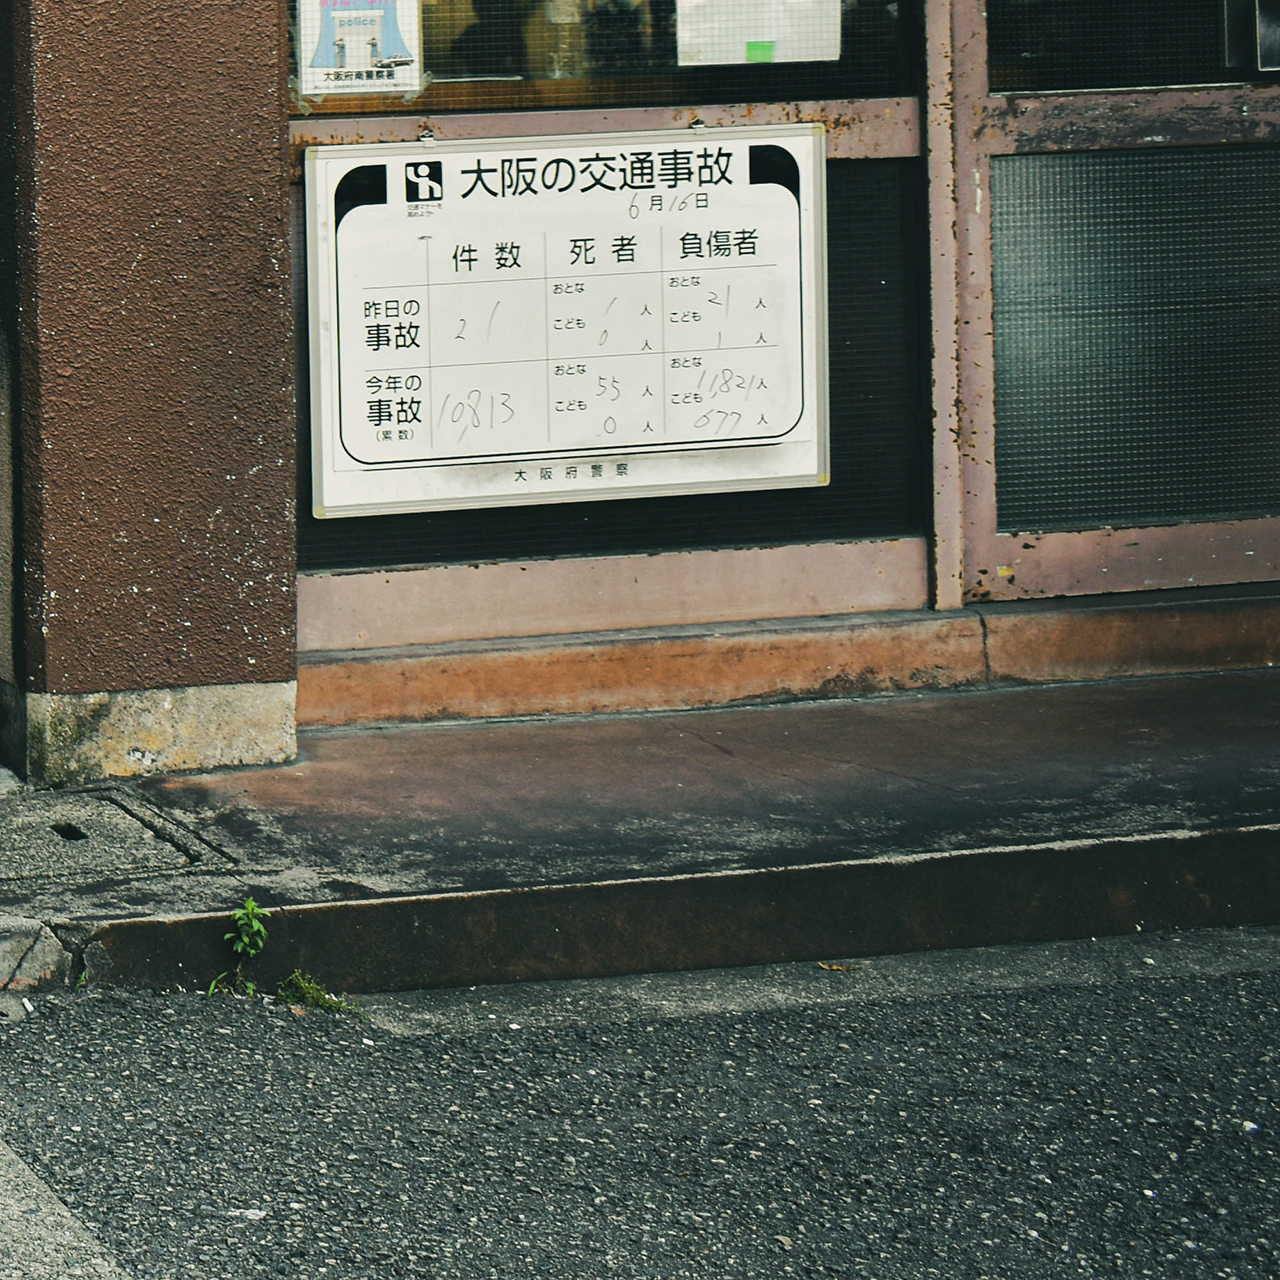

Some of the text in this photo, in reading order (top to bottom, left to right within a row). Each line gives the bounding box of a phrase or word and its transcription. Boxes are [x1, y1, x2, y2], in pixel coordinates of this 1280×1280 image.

[338, 16, 377, 29] police
[460, 146, 734, 200] 大阪の交通事故
[569, 235, 638, 265] 死者
[679, 228, 759, 260] 負傷者
[452, 241, 522, 272] 件数
[552, 282, 586, 295] おとな
[669, 276, 701, 288] おとな
[363, 299, 421, 319] 昨日の
[640, 303, 652, 316] 人
[755, 297, 767, 309] 人
[669, 311, 702, 323] こども
[553, 318, 586, 330] こども
[365, 321, 421, 352] 事故
[755, 332, 768, 344] 人
[641, 339, 653, 351] 人
[670, 357, 703, 369] おとな
[554, 364, 587, 376] おとな
[365, 374, 423, 395] 今年の
[596, 375, 621, 402] 55
[756, 377, 768, 390] 人
[641, 385, 653, 397] 人
[671, 392, 703, 405] こども
[366, 396, 423, 427] 事故
[555, 399, 588, 412] こども
[603, 416, 617, 435] 0
[757, 413, 769, 425] 人
[642, 421, 654, 433] 人
[514, 462, 629, 482] 大阪府警察
